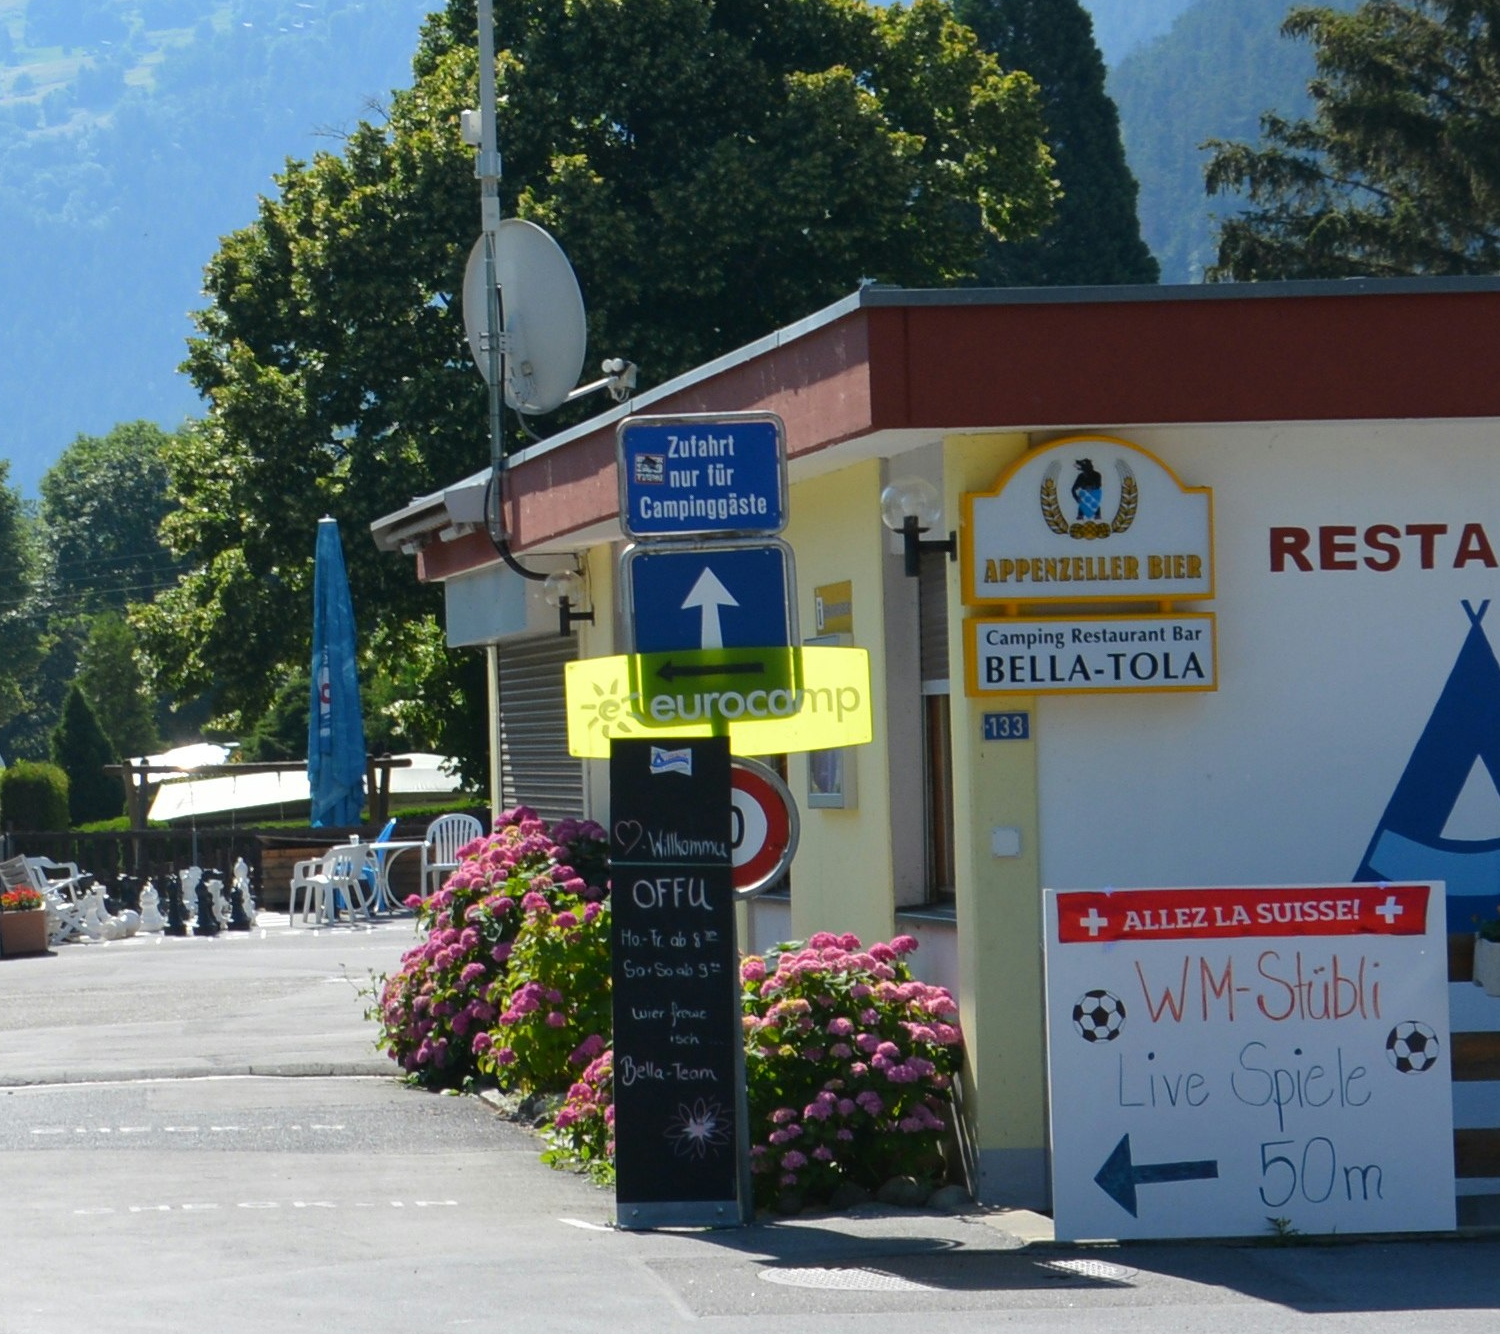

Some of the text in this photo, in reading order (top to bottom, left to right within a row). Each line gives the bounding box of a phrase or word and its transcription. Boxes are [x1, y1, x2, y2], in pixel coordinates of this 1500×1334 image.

[667, 434, 735, 459] Zufahrt
[670, 463, 735, 487] nur für
[639, 493, 767, 521] Campinggäste
[983, 554, 1203, 584] APPENZELLER BIER
[986, 625, 1203, 649] Camping Restaurant Bar
[985, 651, 1206, 684] BELLA-TOLA
[650, 685, 861, 723] eurocamp
[989, 716, 1025, 737] 133
[633, 877, 713, 910] OFFU
[1122, 900, 1361, 932] ALLEZ LA SUISSE!
[670, 931, 687, 948] ab
[1134, 950, 1381, 1022] WM-Stübli
[620, 1055, 718, 1086] Bella-Team
[1118, 1041, 1372, 1133] Live Spiele
[1258, 1136, 1383, 1207] 50m
